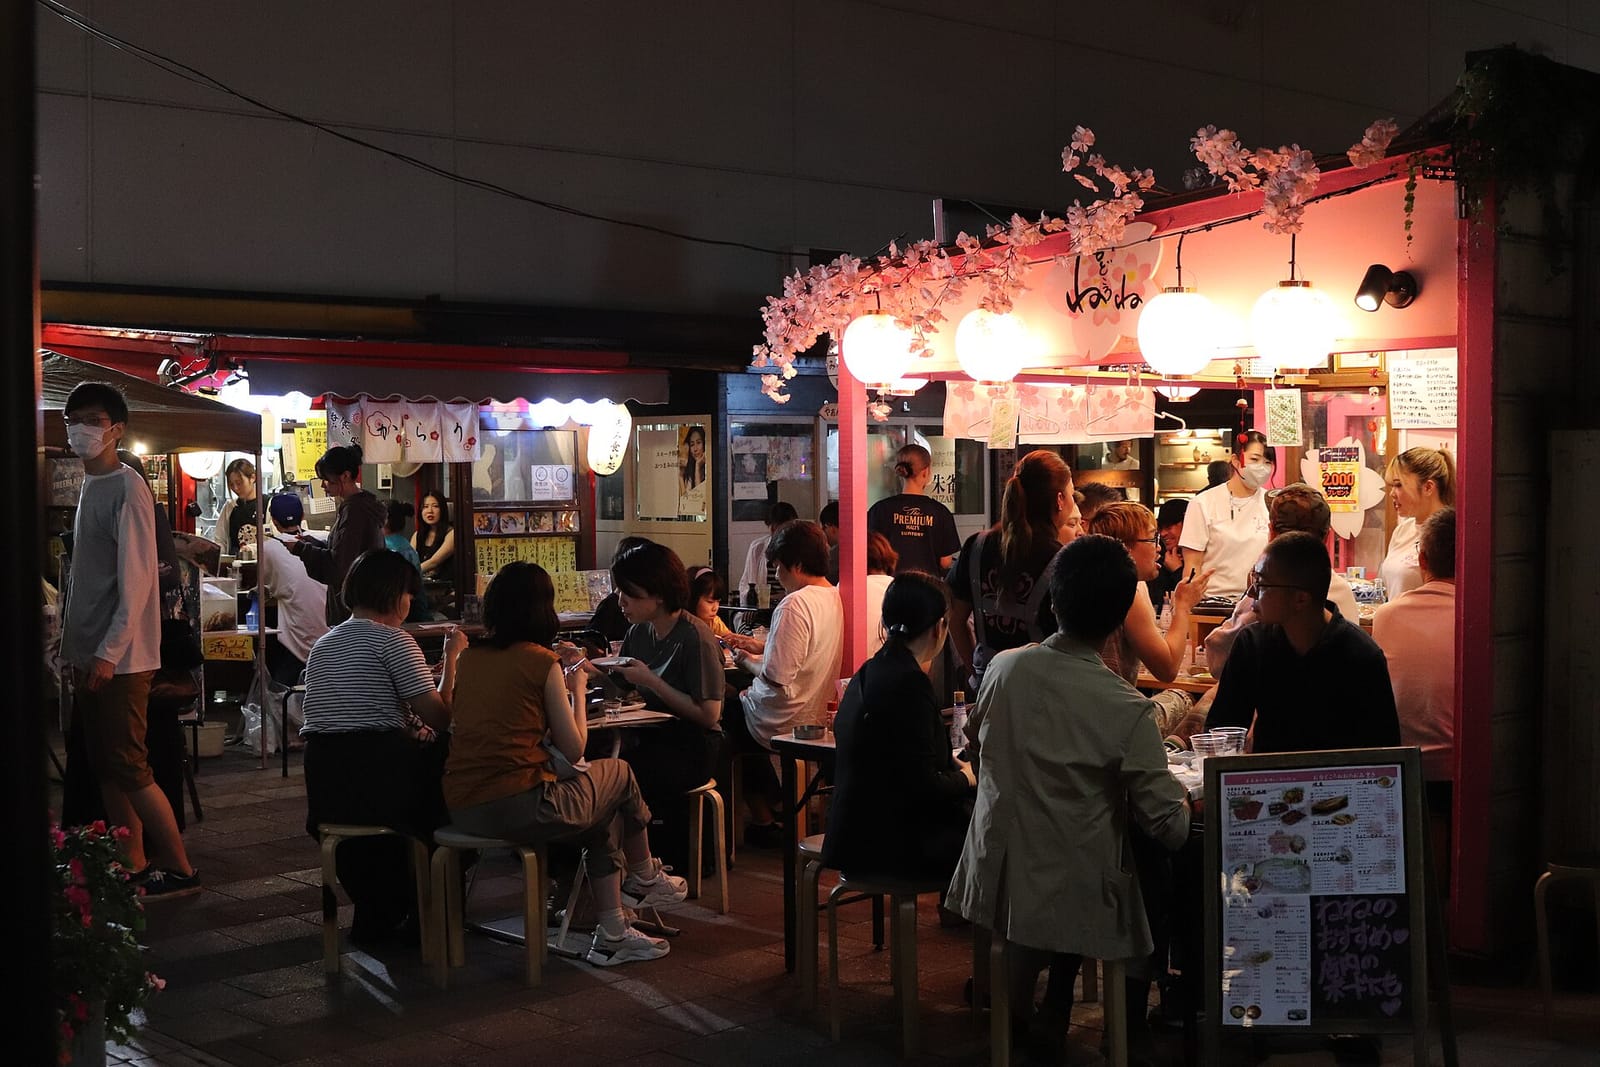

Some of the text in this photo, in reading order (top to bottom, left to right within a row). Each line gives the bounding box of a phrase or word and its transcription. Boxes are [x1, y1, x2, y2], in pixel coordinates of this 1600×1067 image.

[376, 421, 464, 443] からり
[932, 474, 957, 494] 朱雀
[893, 512, 935, 527] PREMIUM
[1315, 896, 1398, 925] ねねの
[1316, 920, 1393, 953] おすすめ
